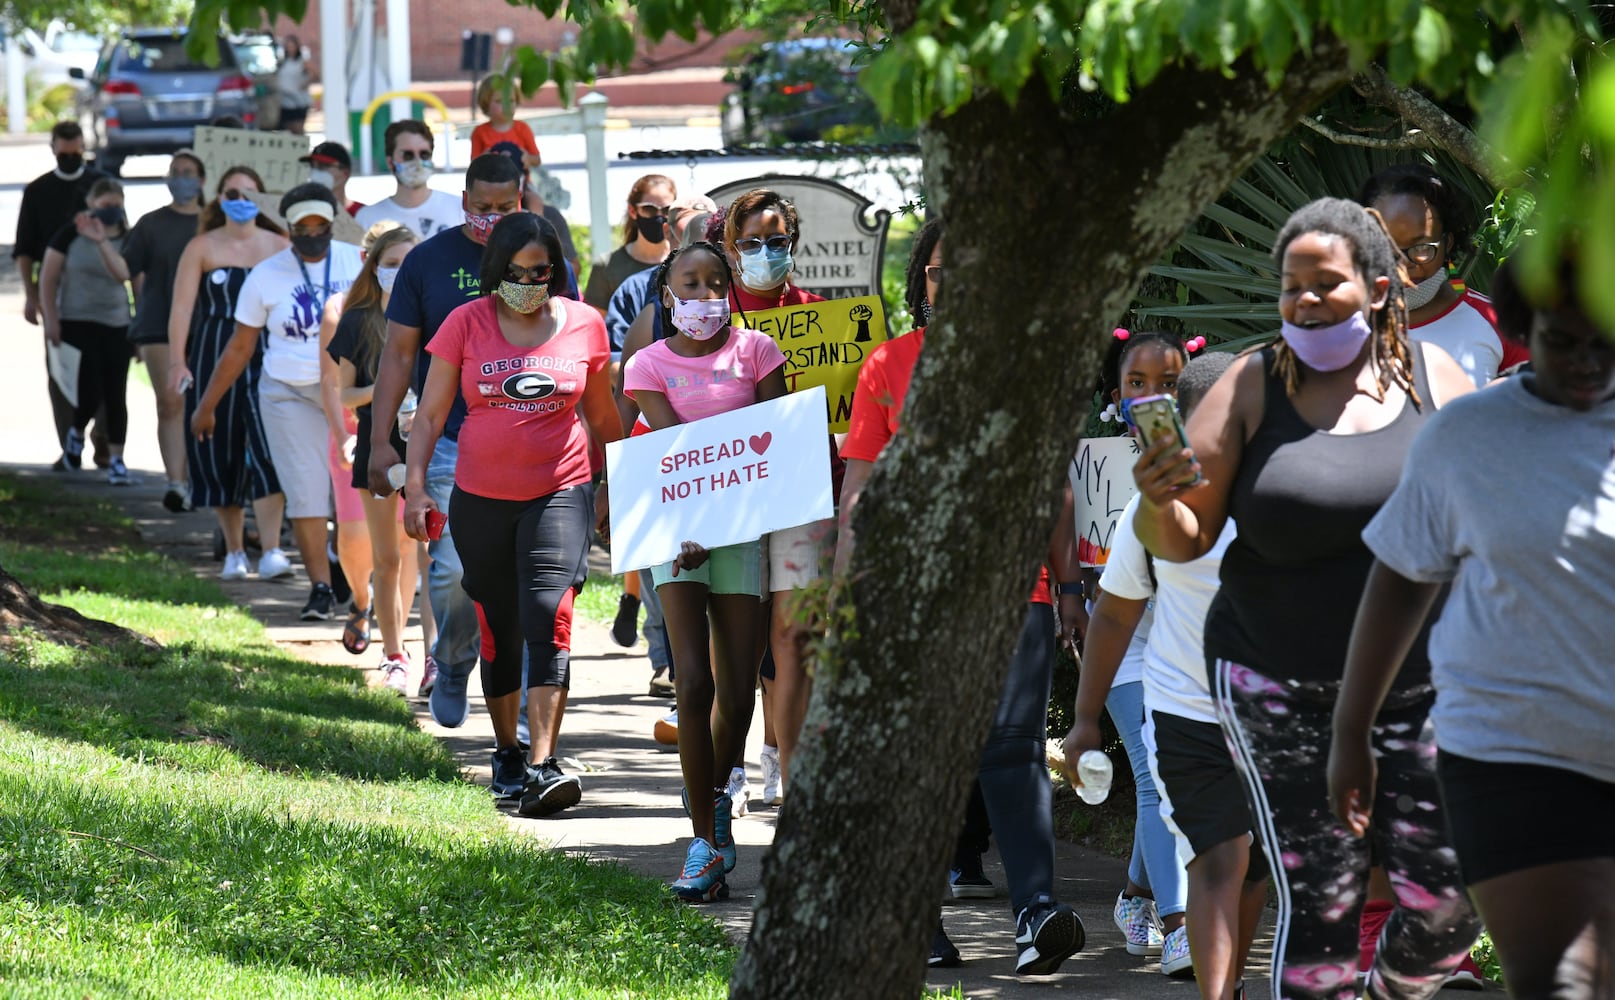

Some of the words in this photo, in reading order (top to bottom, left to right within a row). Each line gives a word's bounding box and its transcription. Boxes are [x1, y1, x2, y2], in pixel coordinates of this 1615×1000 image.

[797, 240, 870, 258] ANIEL
[481, 356, 577, 376] GEORGIA
[783, 342, 863, 370] RSTAND
[661, 438, 745, 474] SPREAD
[661, 476, 705, 504] NOT
[711, 460, 769, 491] HATE
[1072, 444, 1107, 505] MY
